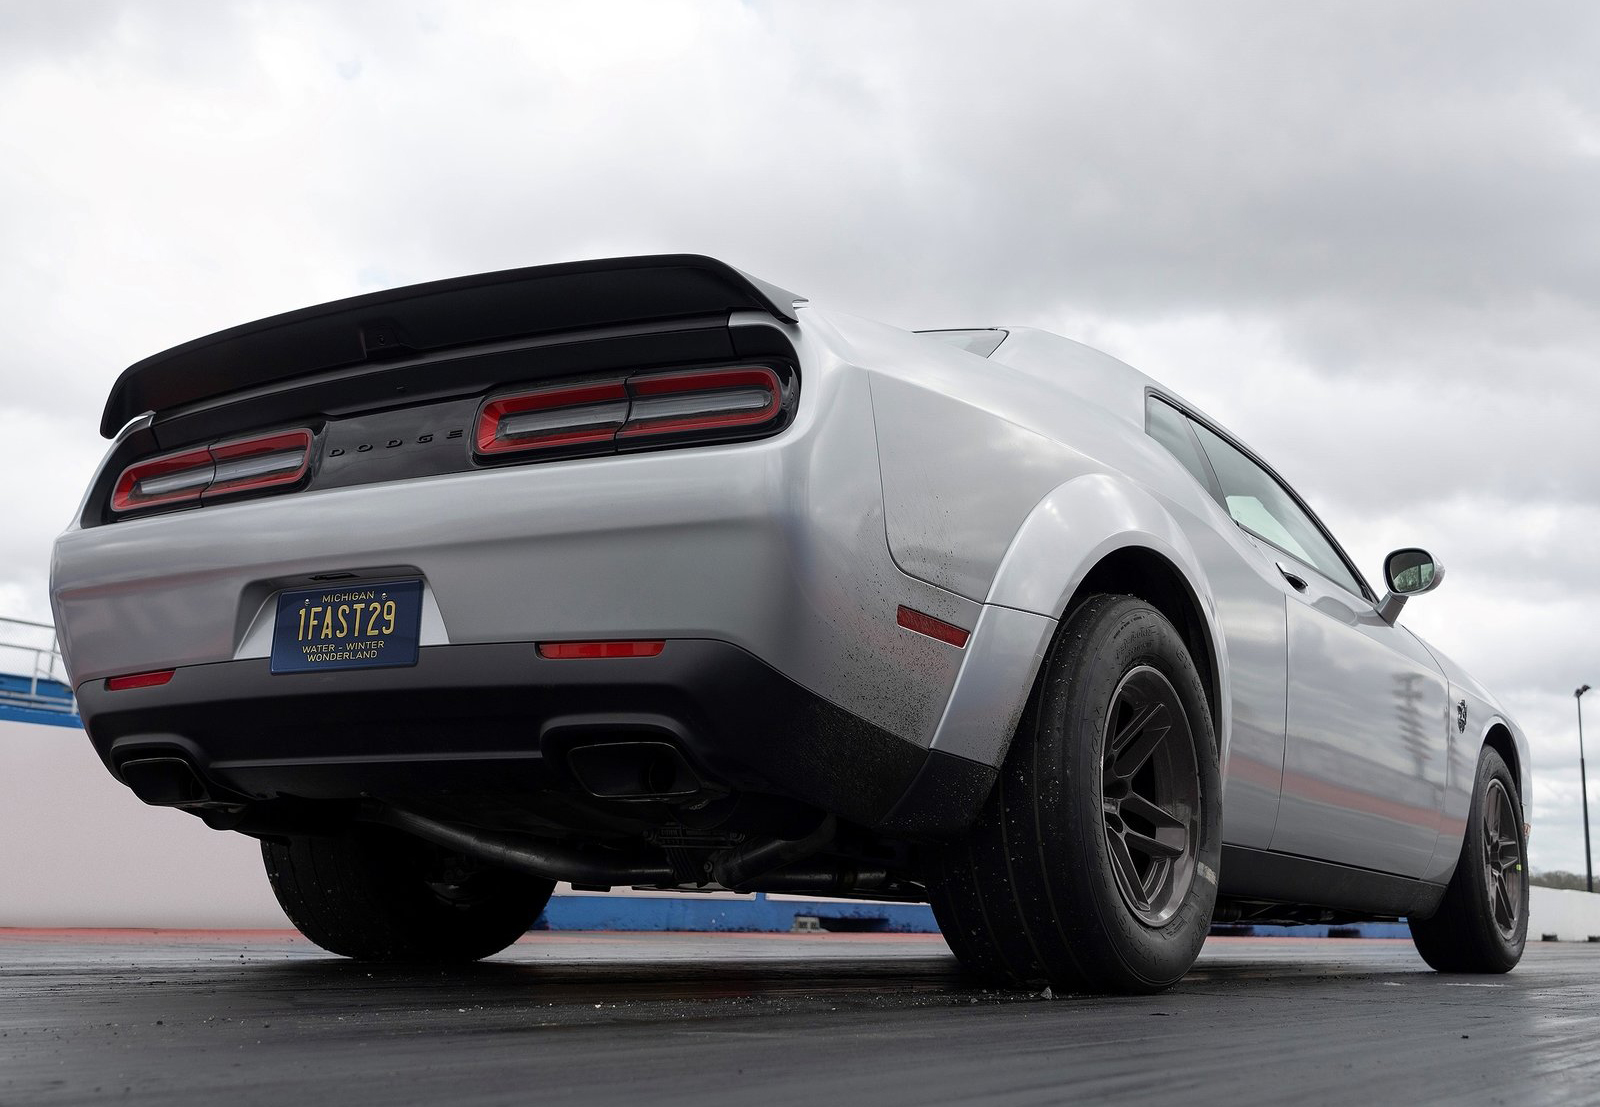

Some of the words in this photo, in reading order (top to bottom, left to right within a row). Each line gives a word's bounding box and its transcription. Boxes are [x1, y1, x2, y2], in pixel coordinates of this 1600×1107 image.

[329, 429, 463, 458] DODGE
[322, 590, 375, 603] MICHIGAN
[298, 600, 397, 641] 1FAST29
[302, 644, 335, 653] WATER
[346, 640, 385, 651] WINTER
[307, 650, 378, 662] WONDERLAND
